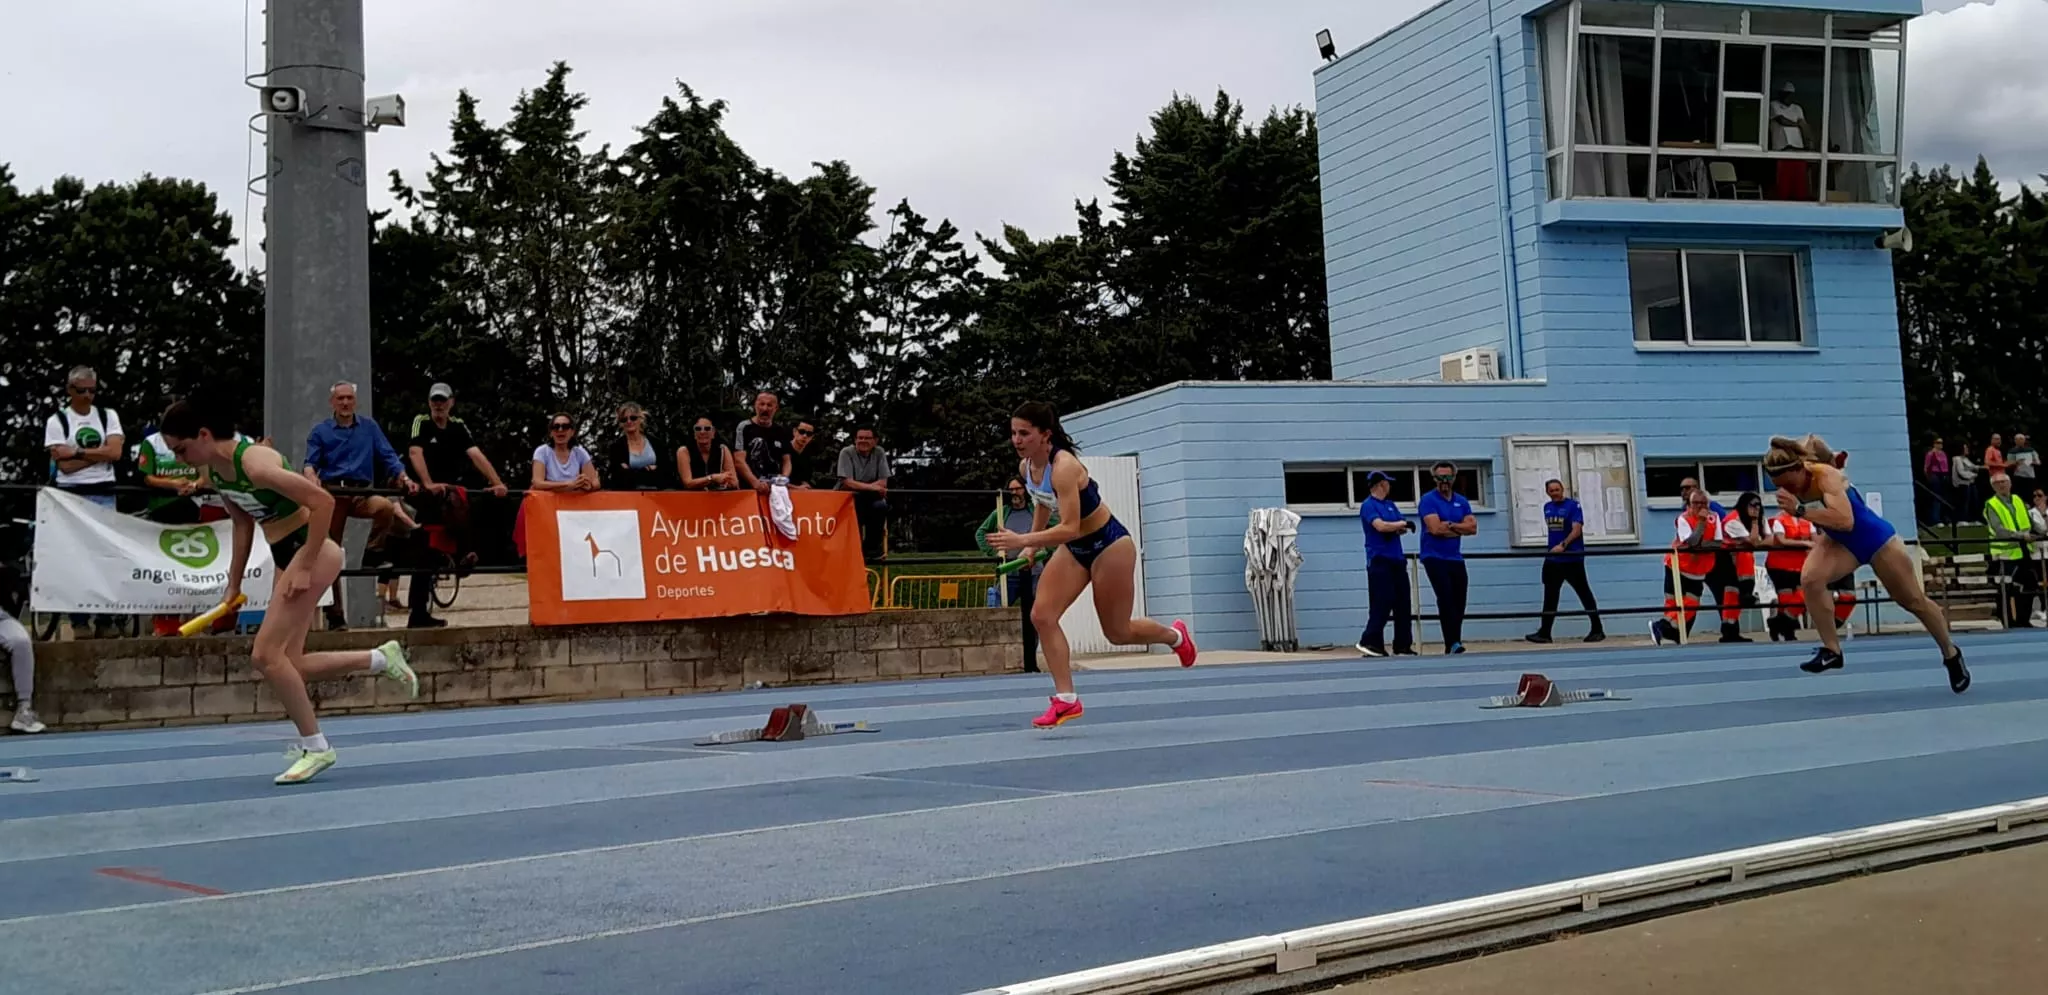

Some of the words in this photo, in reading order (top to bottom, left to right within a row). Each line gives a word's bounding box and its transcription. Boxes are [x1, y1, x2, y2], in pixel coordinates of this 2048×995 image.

[156, 466, 196, 476] Huesca
[651, 511, 836, 545] Ayuntamnto
[655, 545, 688, 574] de
[696, 545, 795, 573] Huesca
[132, 567, 176, 584] angel
[657, 585, 715, 599] Deportes
